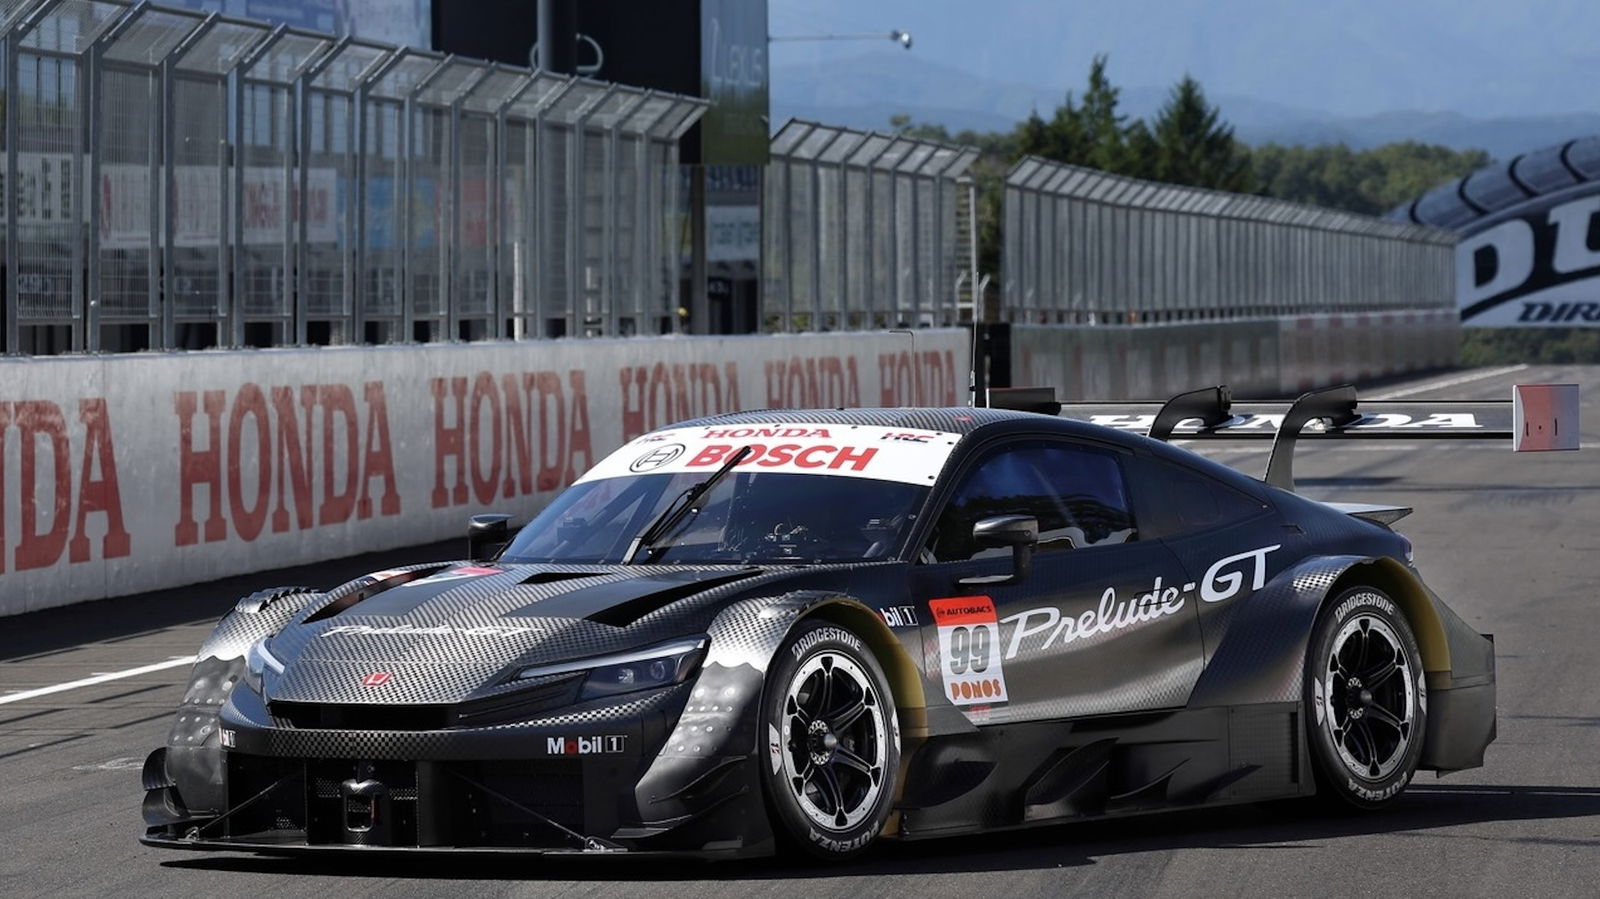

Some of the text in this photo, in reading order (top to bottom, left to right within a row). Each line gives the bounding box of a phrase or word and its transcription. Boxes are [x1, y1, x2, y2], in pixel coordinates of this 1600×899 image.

[879, 350, 957, 408] HONDA
[431, 370, 593, 509] HONDA
[701, 428, 831, 438] HONDA
[174, 382, 401, 547] HONDA
[685, 444, 879, 471] BOSCH
[0, 396, 131, 575] DA
[946, 606, 993, 616] AUTOBACS
[1000, 544, 1281, 660] Prelude-GT
[1334, 593, 1395, 623] BRIDGESTONE
[791, 627, 863, 662] BRIDGESTONE
[950, 625, 991, 675] 99
[950, 679, 1002, 700] PONOS
[547, 736, 602, 755] Mobil
[1348, 771, 1408, 800] POTENZA
[809, 820, 879, 852] POTENZA
